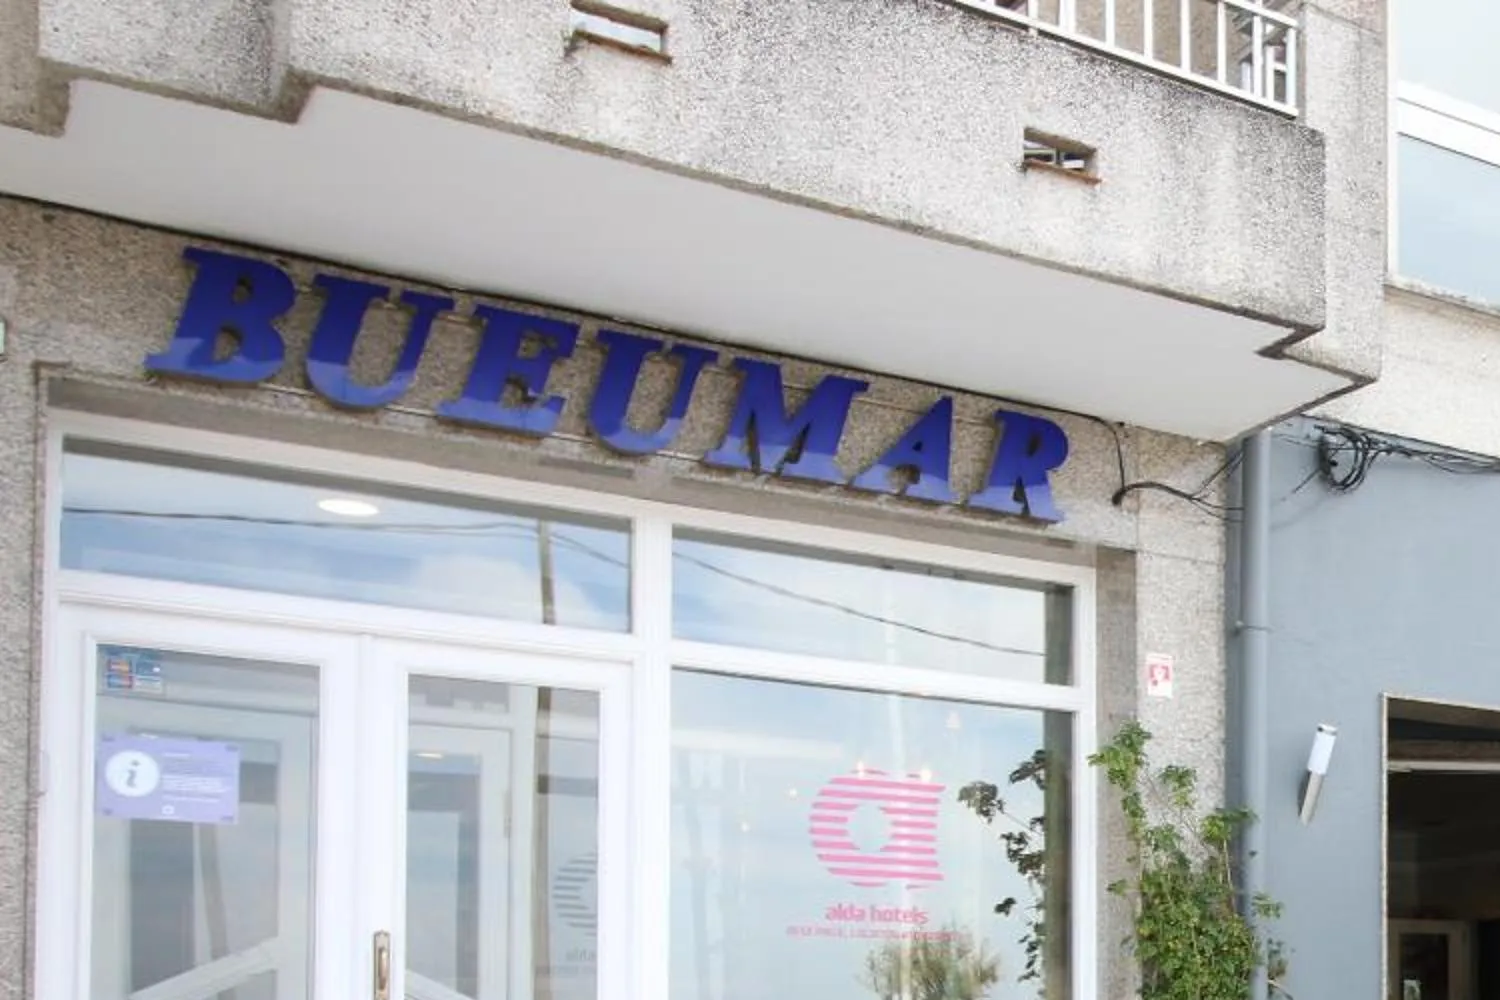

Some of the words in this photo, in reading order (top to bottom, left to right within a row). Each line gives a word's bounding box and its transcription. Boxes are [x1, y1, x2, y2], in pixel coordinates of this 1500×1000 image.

[146, 246, 1070, 523] BUEUMAR
[825, 903, 866, 922] alda
[870, 904, 930, 925] hotels
